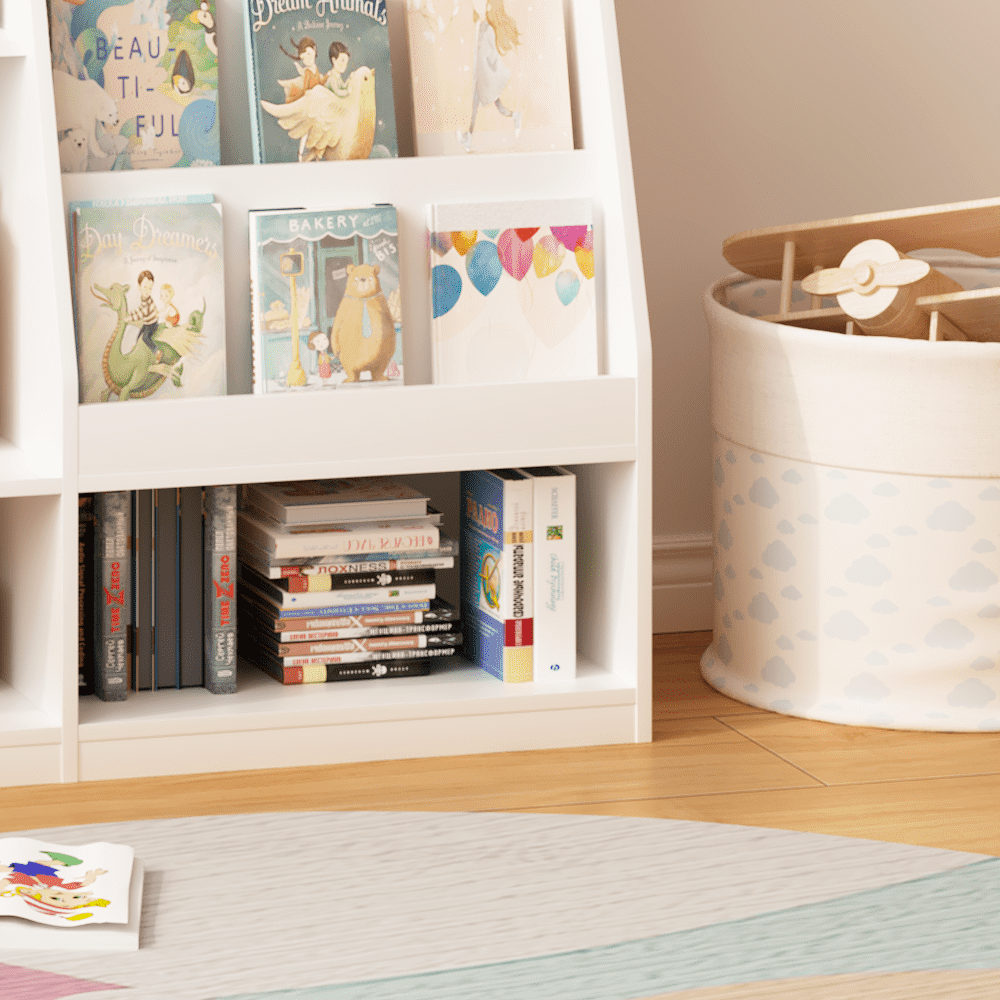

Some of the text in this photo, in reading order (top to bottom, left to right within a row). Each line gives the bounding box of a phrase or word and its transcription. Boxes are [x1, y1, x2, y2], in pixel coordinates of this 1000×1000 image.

[95, 36, 176, 61] BEAU-
[118, 76, 154, 98] TI-
[136, 114, 179, 137] FUL
[289, 214, 359, 233] BAKERY
[79, 212, 218, 262] Day Dreamers
[220, 555, 230, 583] ZERO
[111, 608, 120, 633] TIME
[220, 601, 230, 626] TIME
